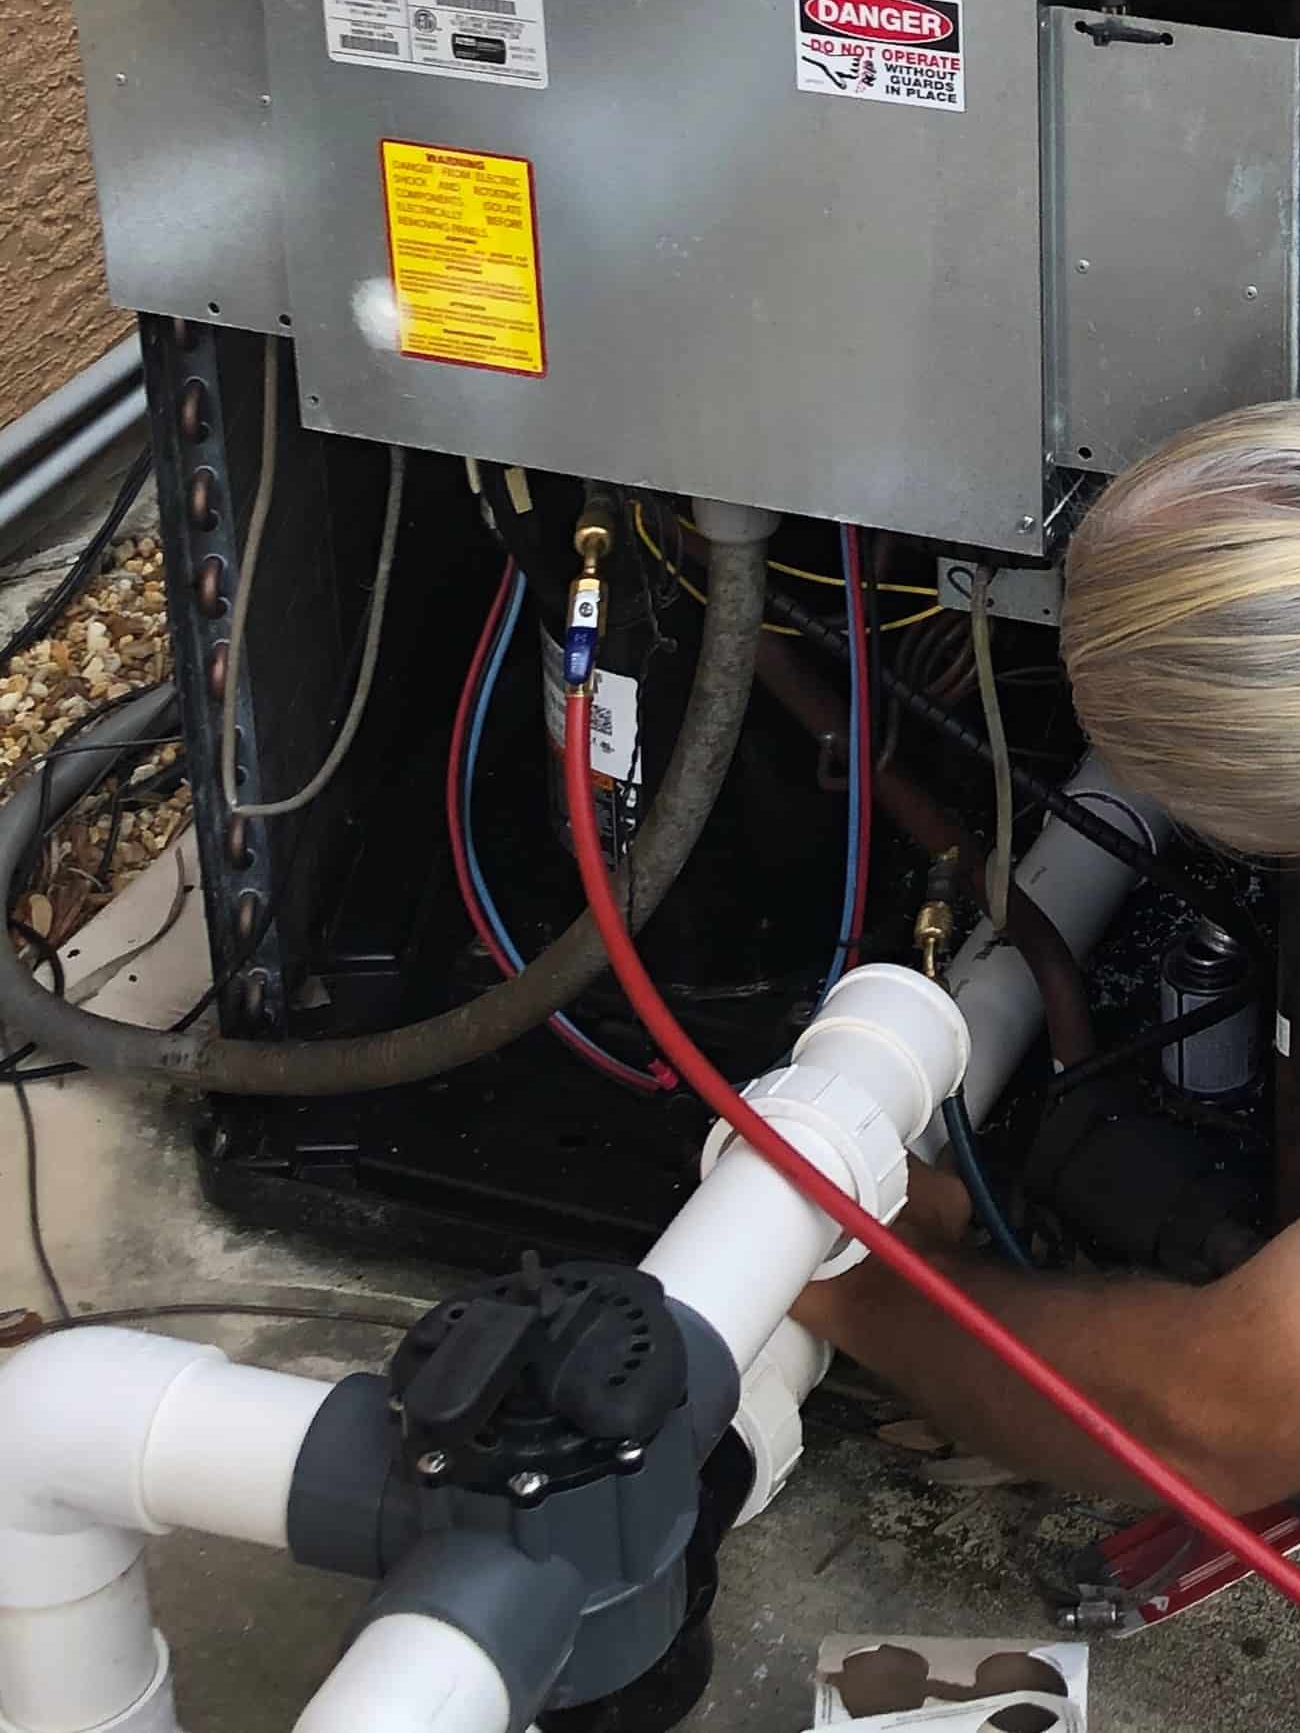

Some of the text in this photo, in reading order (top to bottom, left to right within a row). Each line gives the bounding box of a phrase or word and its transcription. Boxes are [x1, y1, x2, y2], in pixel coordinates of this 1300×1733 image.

[810, 38, 961, 71] DO NOT OPERATE
[885, 63, 957, 82] WITHOUT
[890, 74, 955, 92] GUARDS
[885, 84, 958, 104] IN PLACE
[425, 152, 486, 171] WARNING
